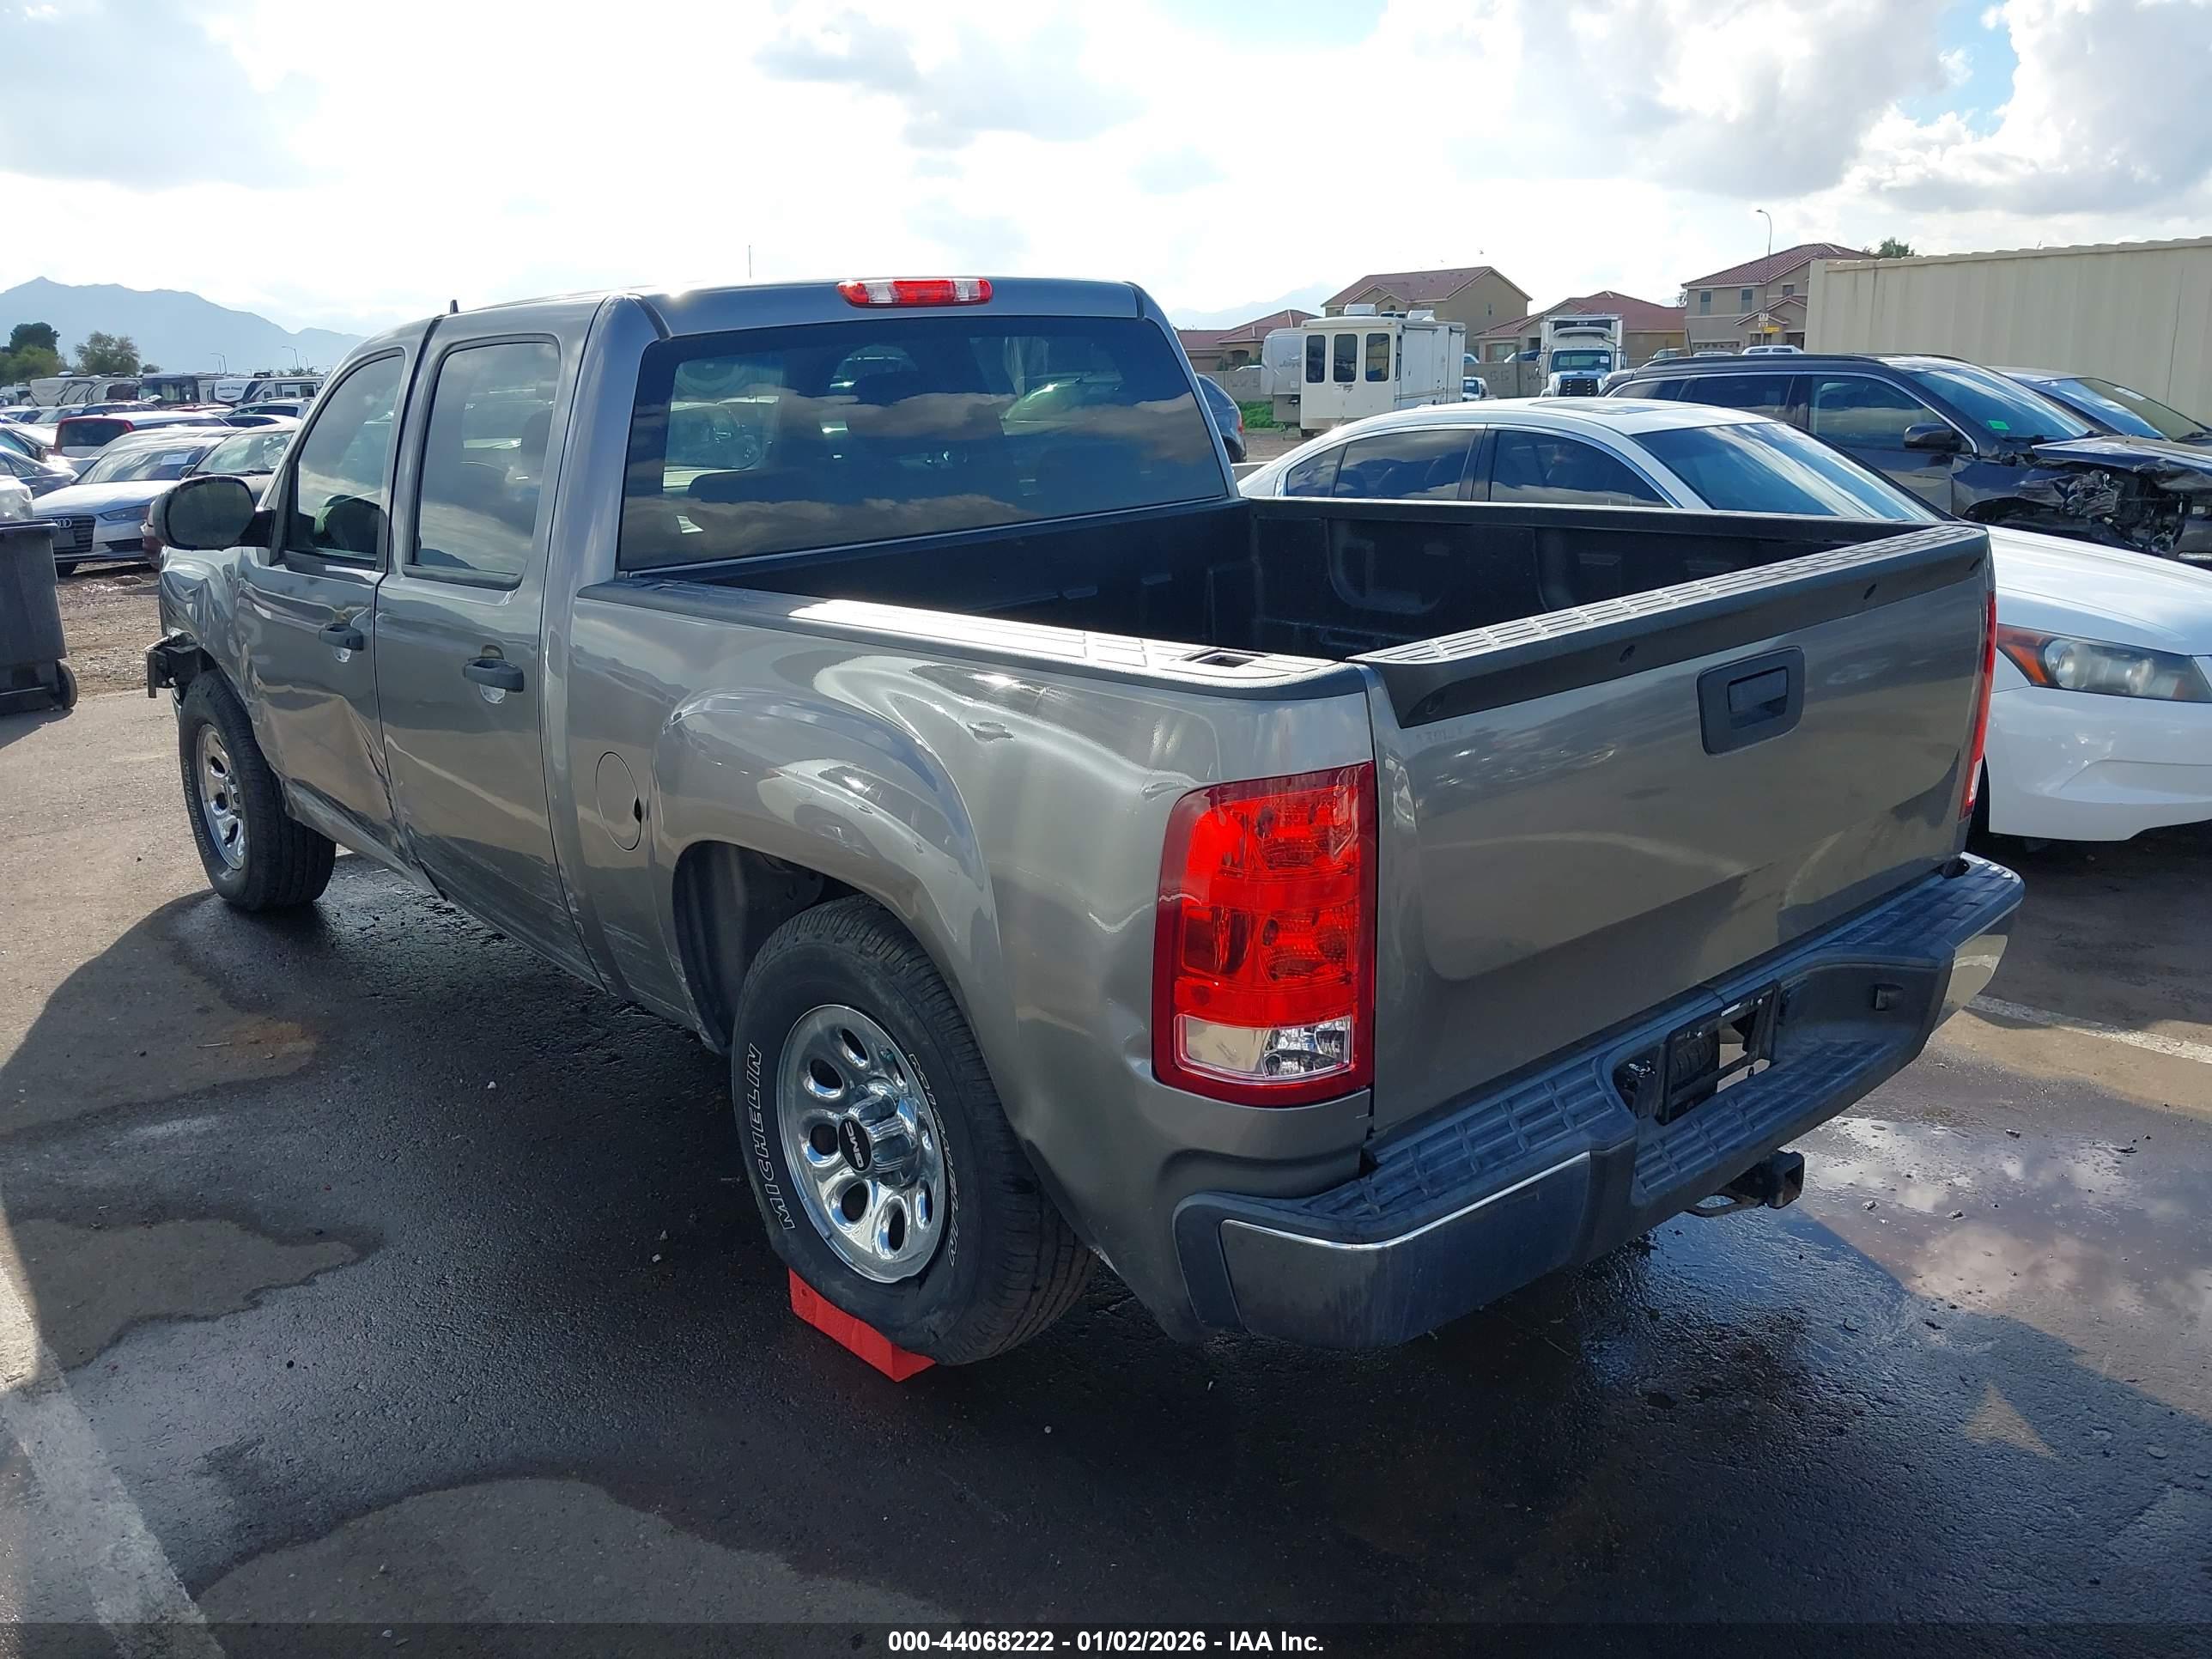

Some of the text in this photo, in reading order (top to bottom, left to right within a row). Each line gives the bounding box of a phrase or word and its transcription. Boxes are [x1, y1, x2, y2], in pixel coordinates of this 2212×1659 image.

[745, 1042, 795, 1231] MICHELIN
[844, 1121, 865, 1169] GMC
[908, 1053, 960, 1267] MICHELIN
